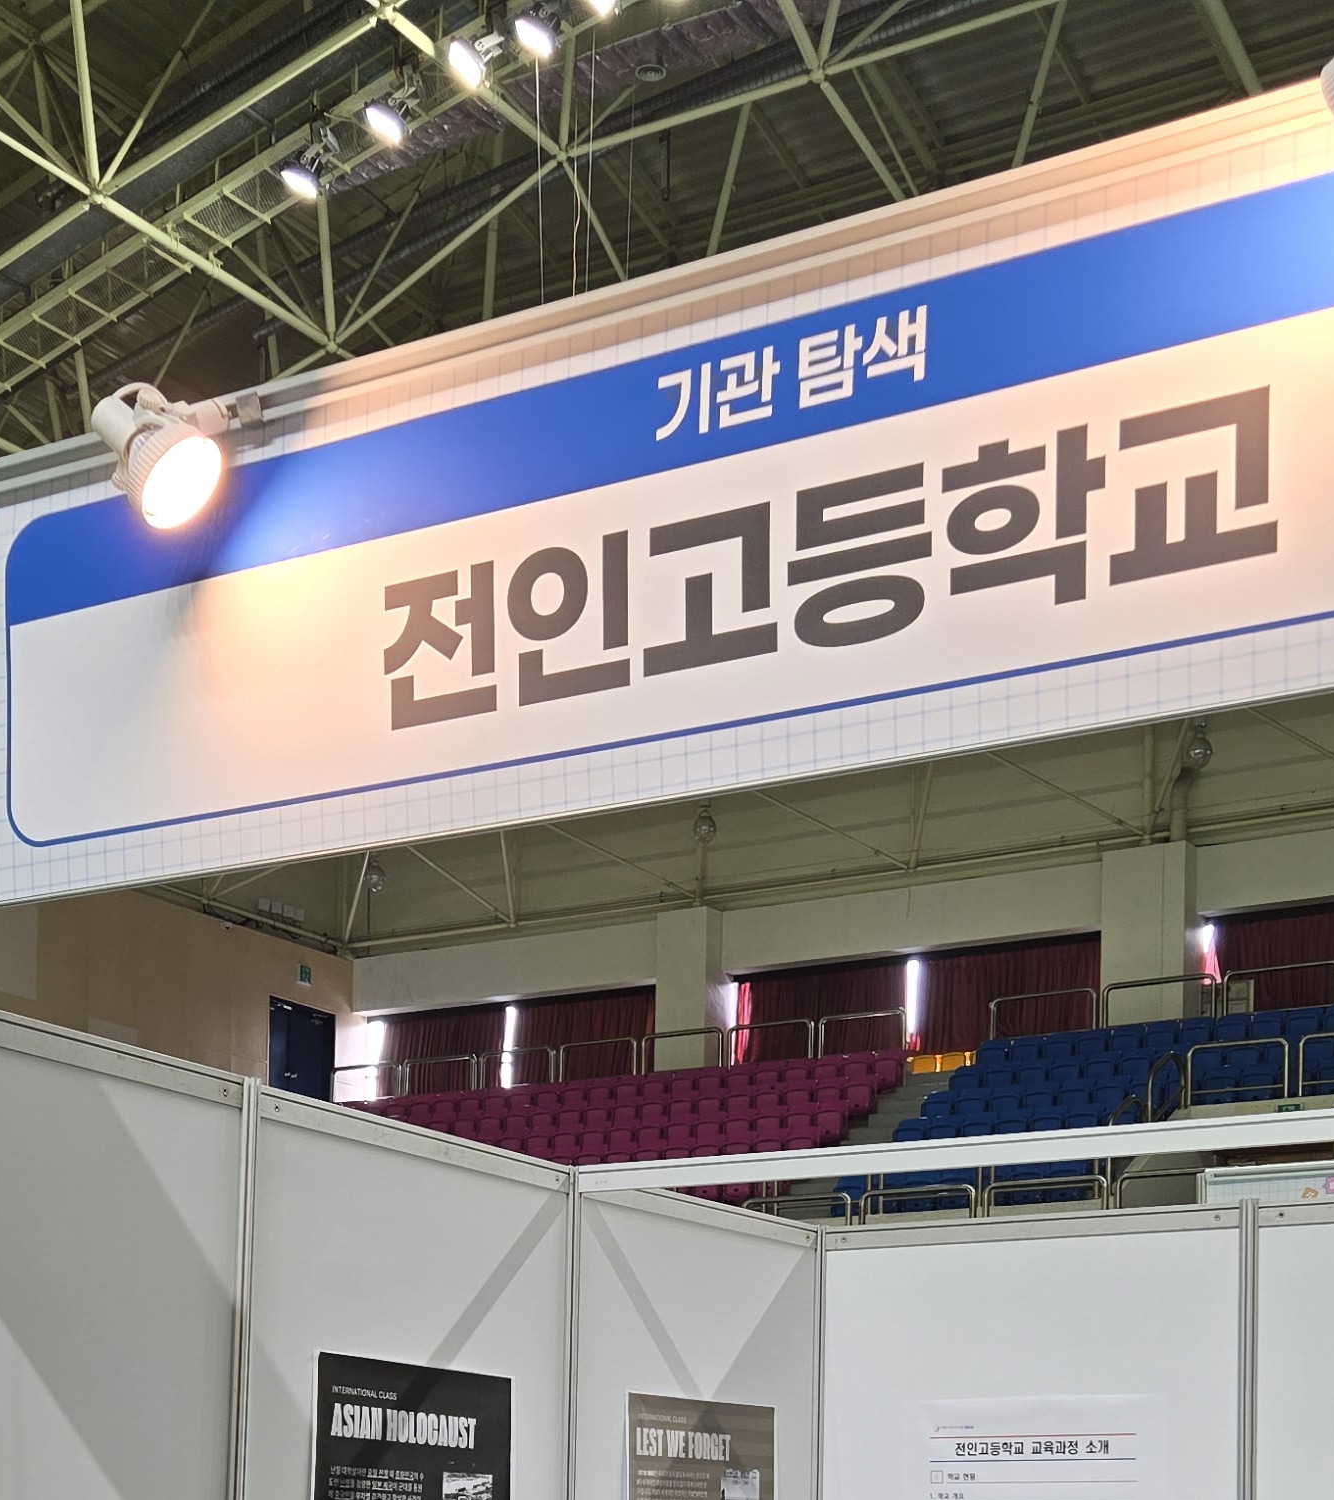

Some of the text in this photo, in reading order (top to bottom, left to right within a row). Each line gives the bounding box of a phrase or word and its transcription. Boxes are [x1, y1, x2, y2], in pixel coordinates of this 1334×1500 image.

[655, 304, 929, 442] 기관 탐색
[383, 384, 1279, 731] 전인고등학교
[332, 1385, 398, 1401] INTERNATIONAL CLASS
[330, 1402, 477, 1450] ASIAN HOLOCAUST
[636, 1427, 732, 1462] LEST WE FORGET
[954, 1439, 1109, 1457] 전인고등학교 교육과정 소개
